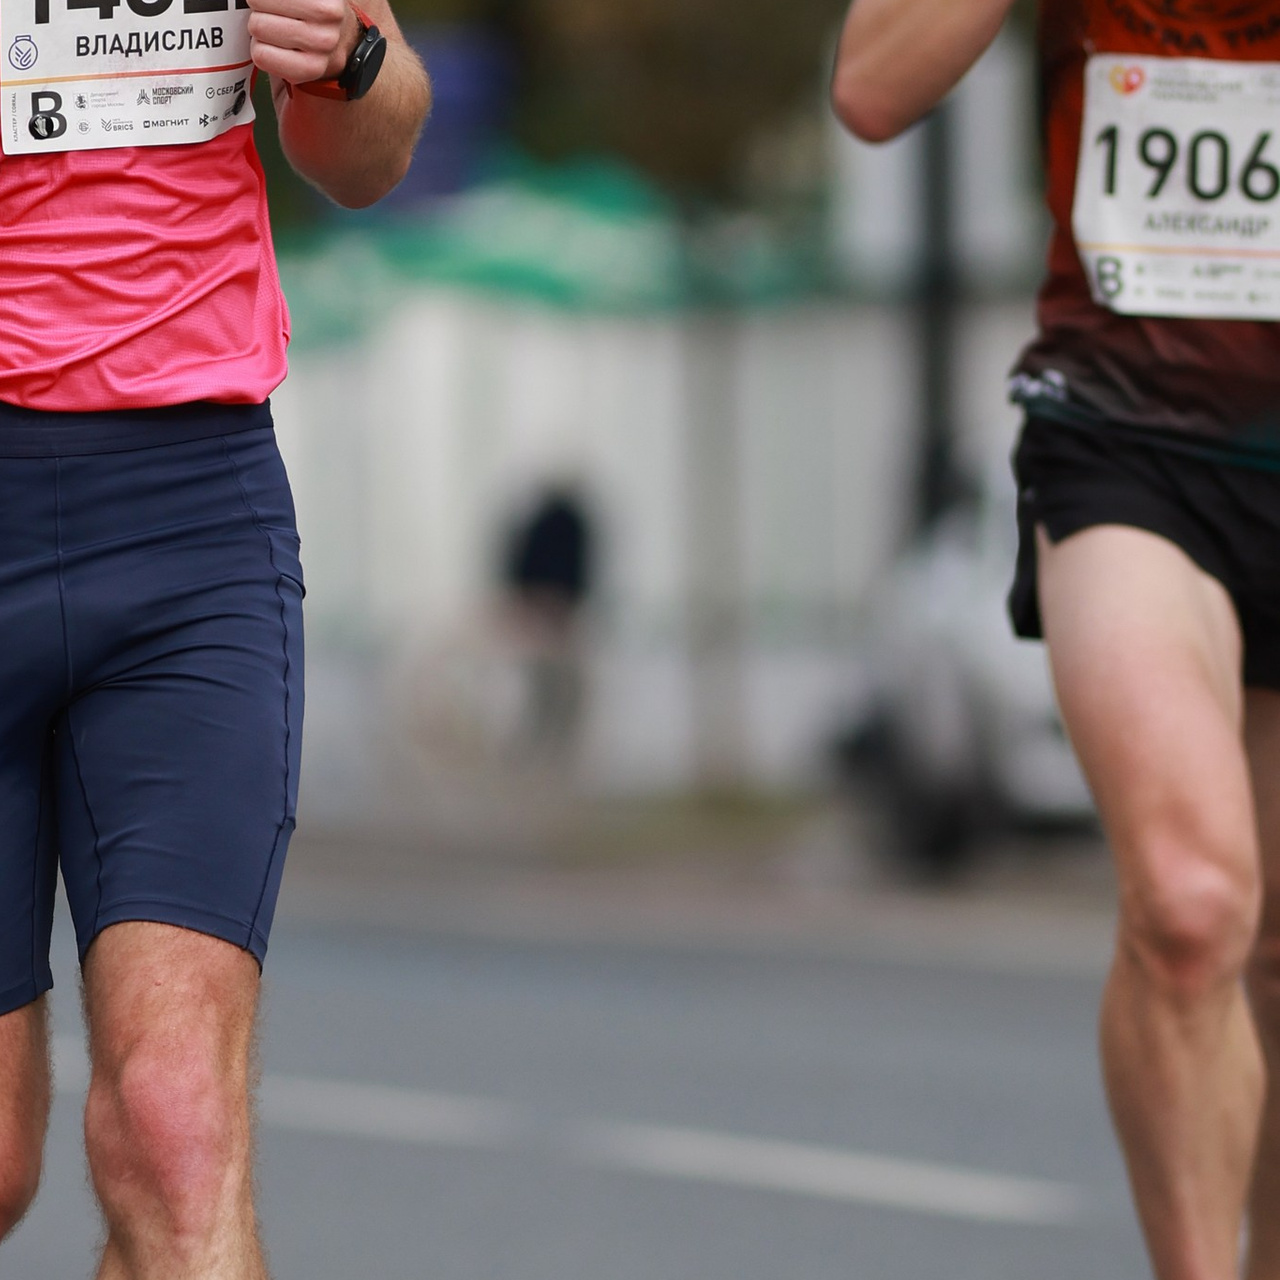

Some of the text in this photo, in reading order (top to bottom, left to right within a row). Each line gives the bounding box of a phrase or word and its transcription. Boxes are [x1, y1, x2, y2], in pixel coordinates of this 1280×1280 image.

[75, 26, 224, 58] ВЛАДИСЛАВ
[152, 83, 194, 96] МОСКОВСКИЙ
[152, 95, 172, 105] СПОРТ
[31, 91, 67, 140] B
[1095, 125, 1280, 202] 1906
